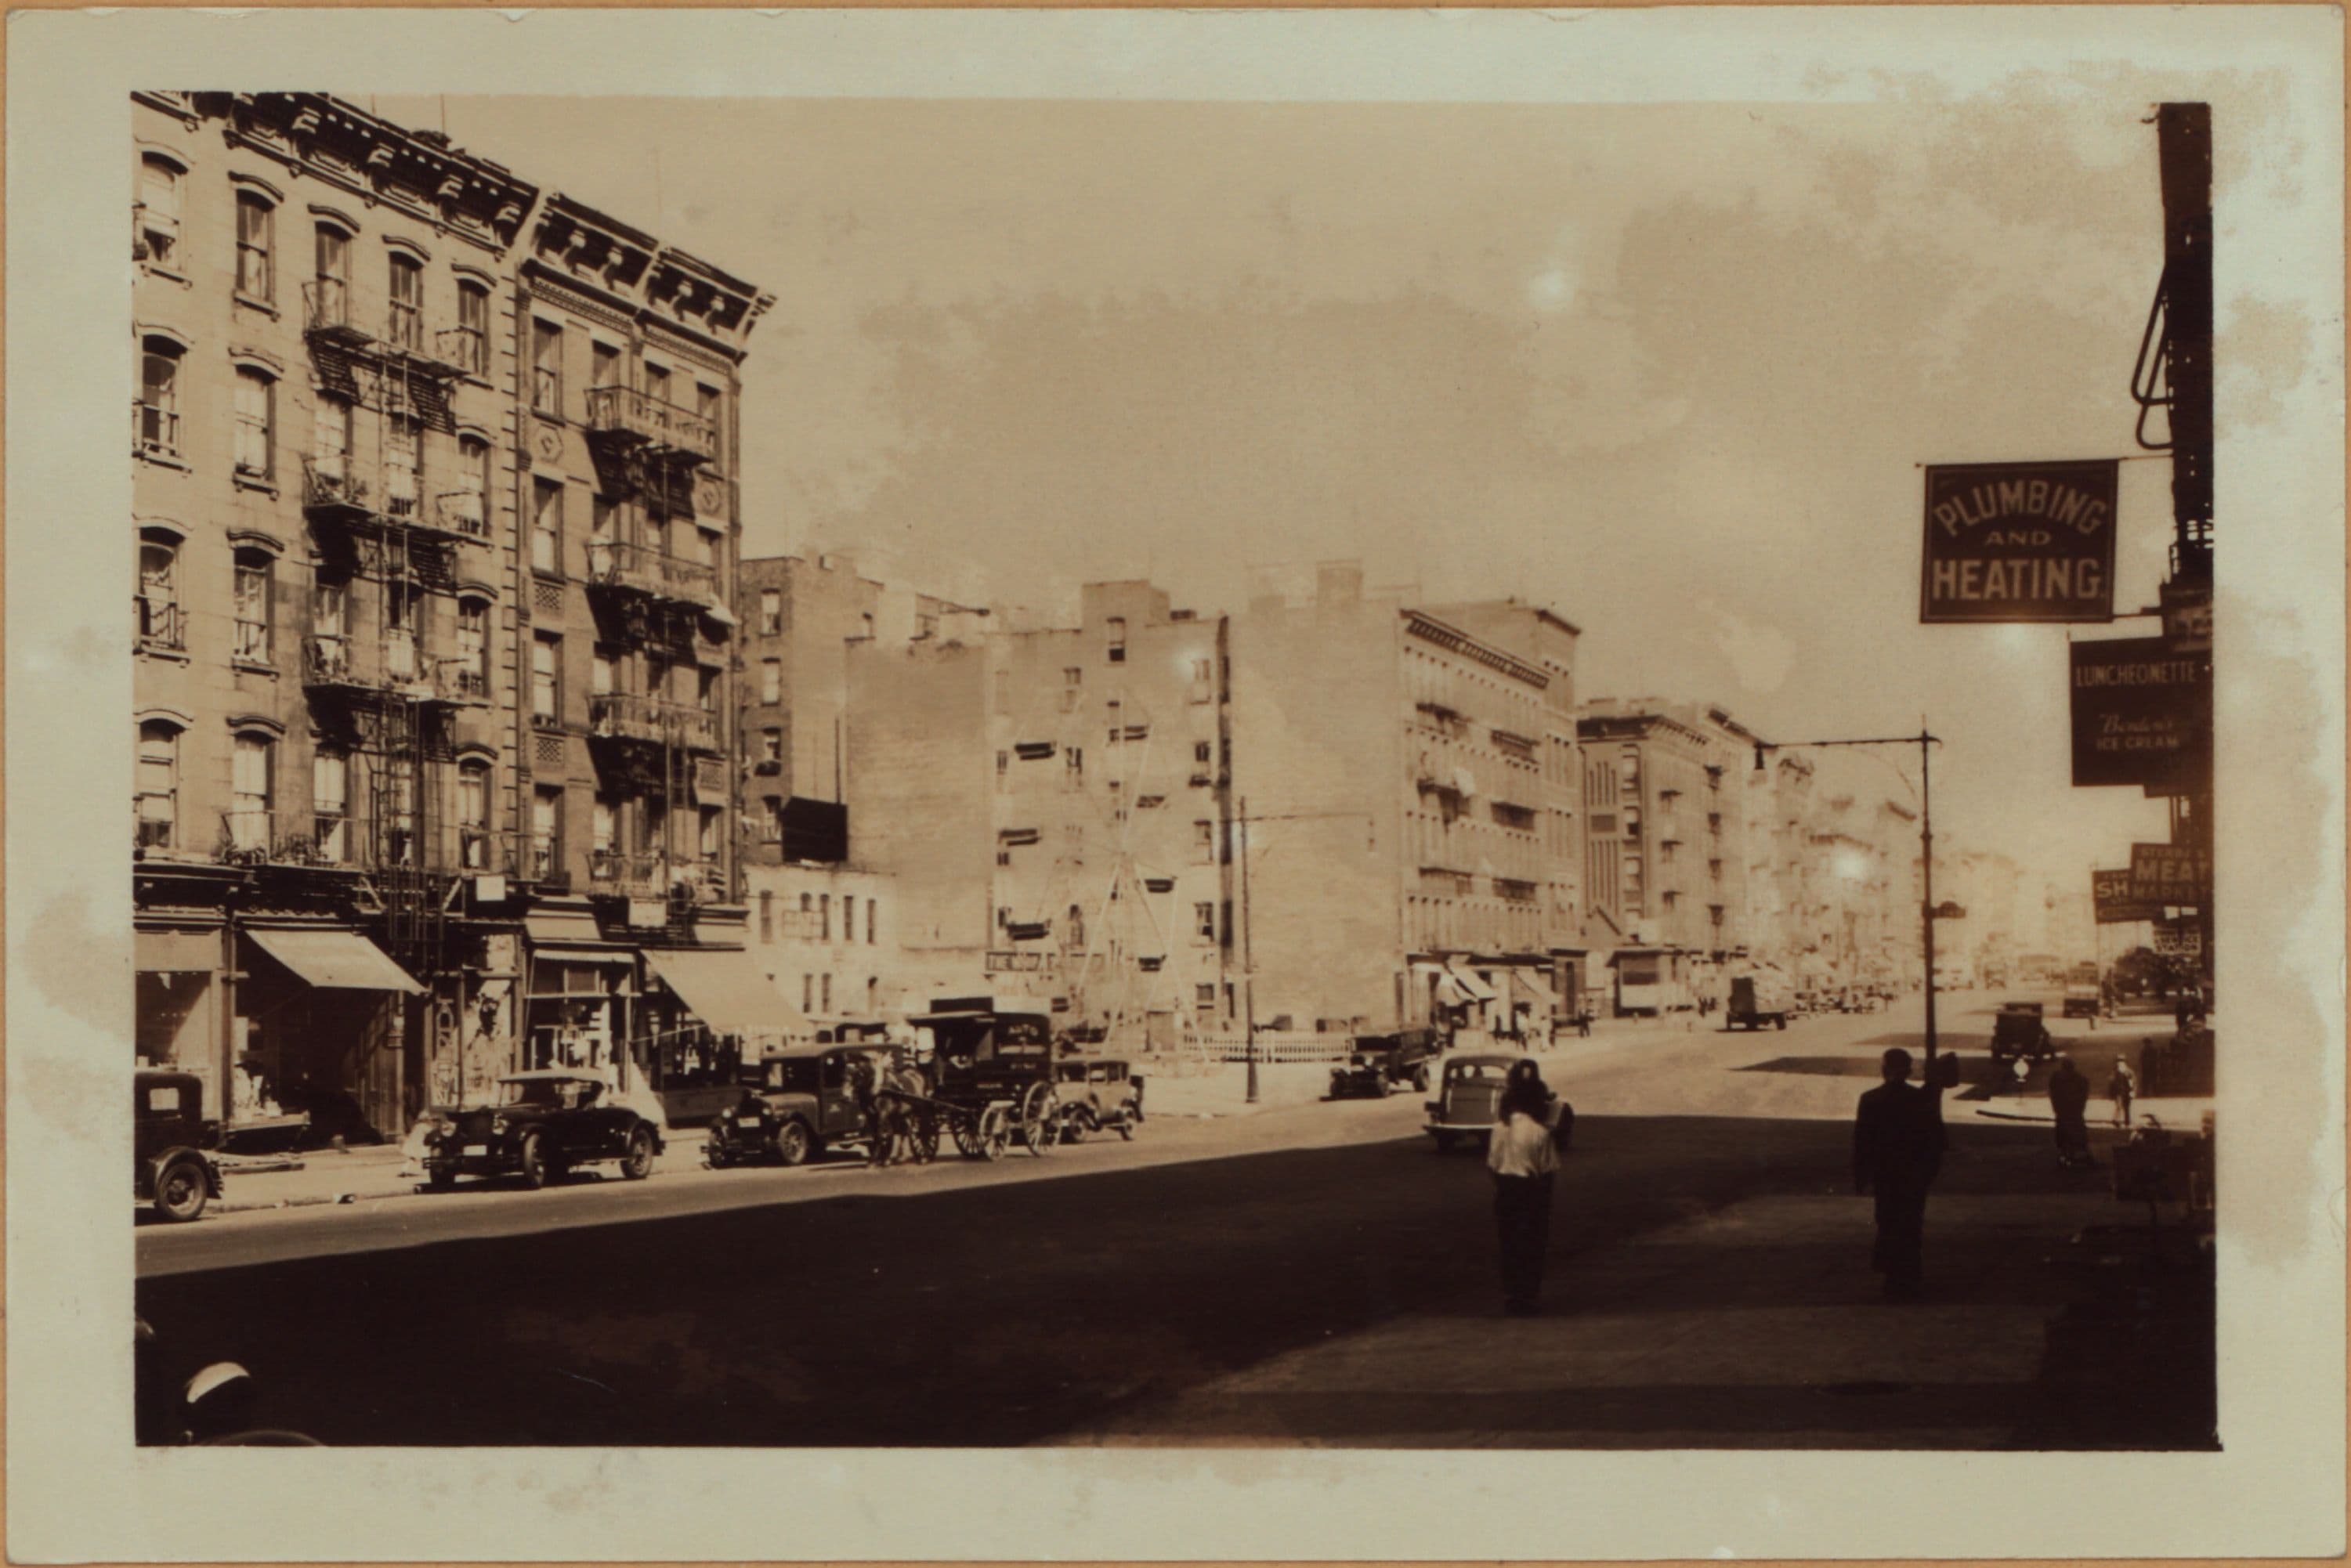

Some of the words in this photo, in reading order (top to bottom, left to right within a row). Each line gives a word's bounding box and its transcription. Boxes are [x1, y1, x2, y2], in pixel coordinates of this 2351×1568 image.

[1933, 479, 2107, 537] PLUMBING
[1985, 531, 2052, 546] AND
[1933, 558, 2101, 600] HEATING
[2075, 662, 2196, 688] LUNCHEONETTE
[2096, 736, 2118, 752] ICE
[2135, 858, 2208, 882] MEAT
